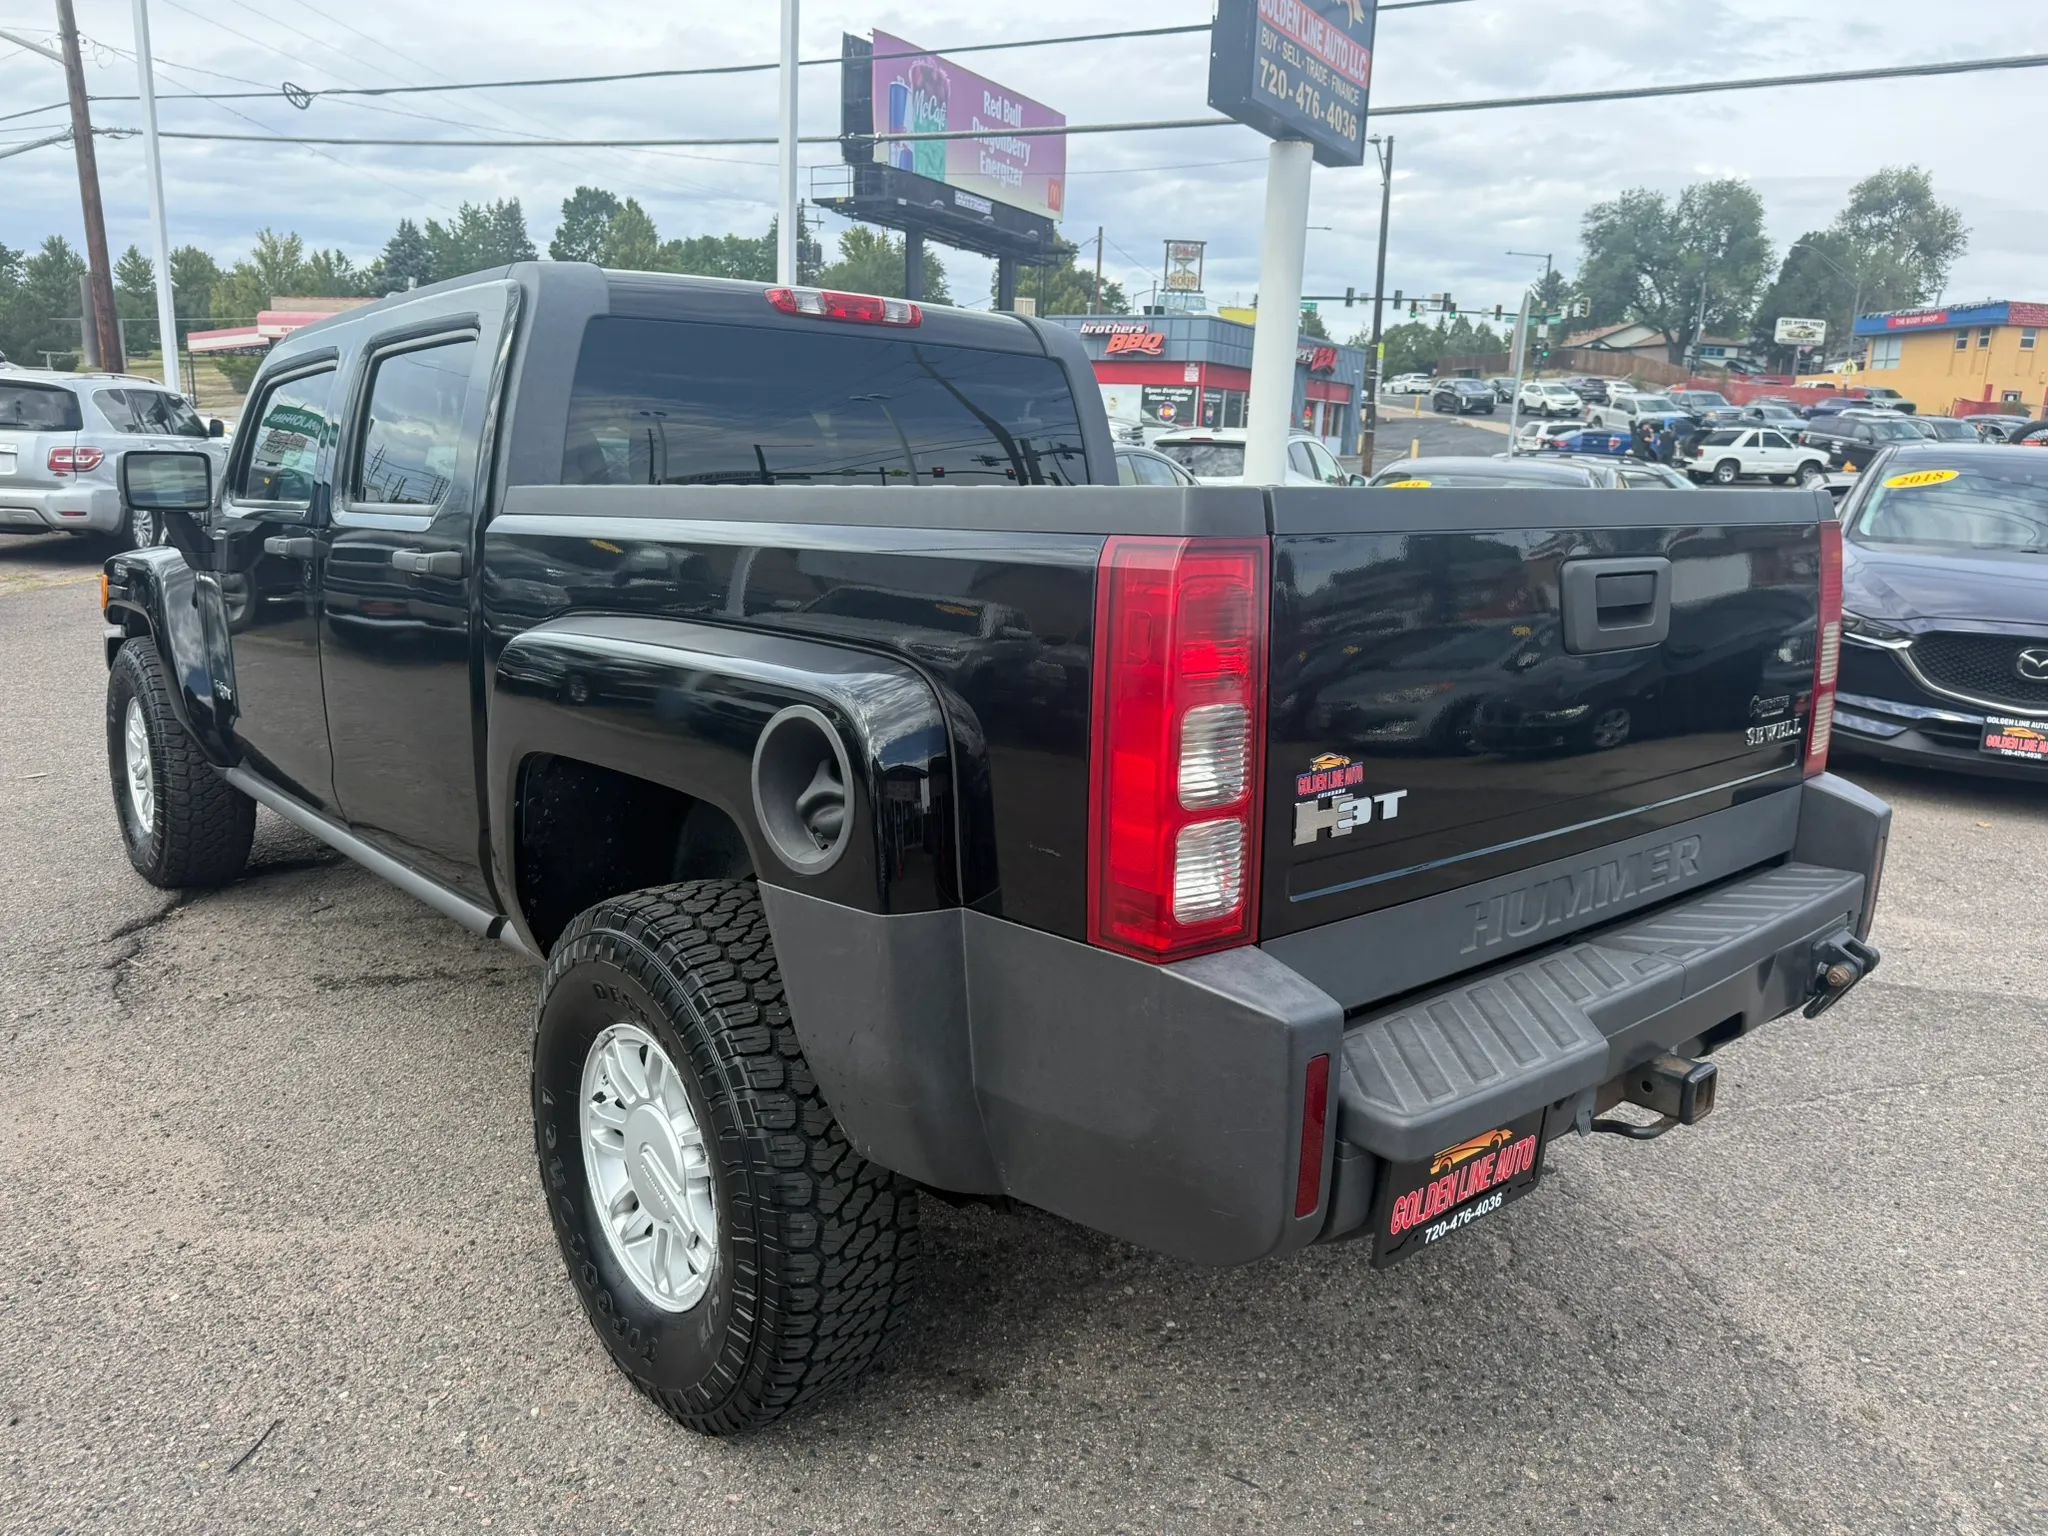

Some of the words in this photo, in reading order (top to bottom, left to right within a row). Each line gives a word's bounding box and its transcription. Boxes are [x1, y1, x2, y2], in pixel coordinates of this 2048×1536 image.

[1302, 10, 1323, 52] LINE
[1324, 28, 1348, 70] AUTO
[1349, 44, 1367, 81] LLC
[1262, 26, 1278, 53] BUY
[1282, 41, 1301, 69] SELL
[1306, 56, 1328, 86] TRADE
[1331, 74, 1360, 106] FINANCE
[983, 90, 1002, 120] Red
[1003, 98, 1023, 130] Bull
[1260, 57, 1358, 142] 720-476-4036
[981, 149, 1023, 189] Energizer
[1080, 323, 1146, 334] brothers
[1105, 333, 1165, 355] BBQ
[1896, 471, 1945, 487] 2018
[1745, 718, 1802, 746] SEWELL
[1986, 716, 2014, 726] GOLDEN
[2015, 720, 2030, 728] LINE
[1986, 735, 2018, 750] GOLDEN
[2018, 738, 2038, 752] LINE
[1298, 772, 1328, 796] GOLDEN
[1328, 769, 1345, 789] LINE
[1345, 765, 1363, 785] AUTO
[1293, 789, 1408, 847] H3T
[1460, 834, 1702, 954] HUMMER
[1391, 1169, 1459, 1234] GOLDEN
[1456, 1152, 1496, 1203] LINE
[1492, 1134, 1536, 1185] AUTO
[1424, 1191, 1503, 1245] 720-476-4036
